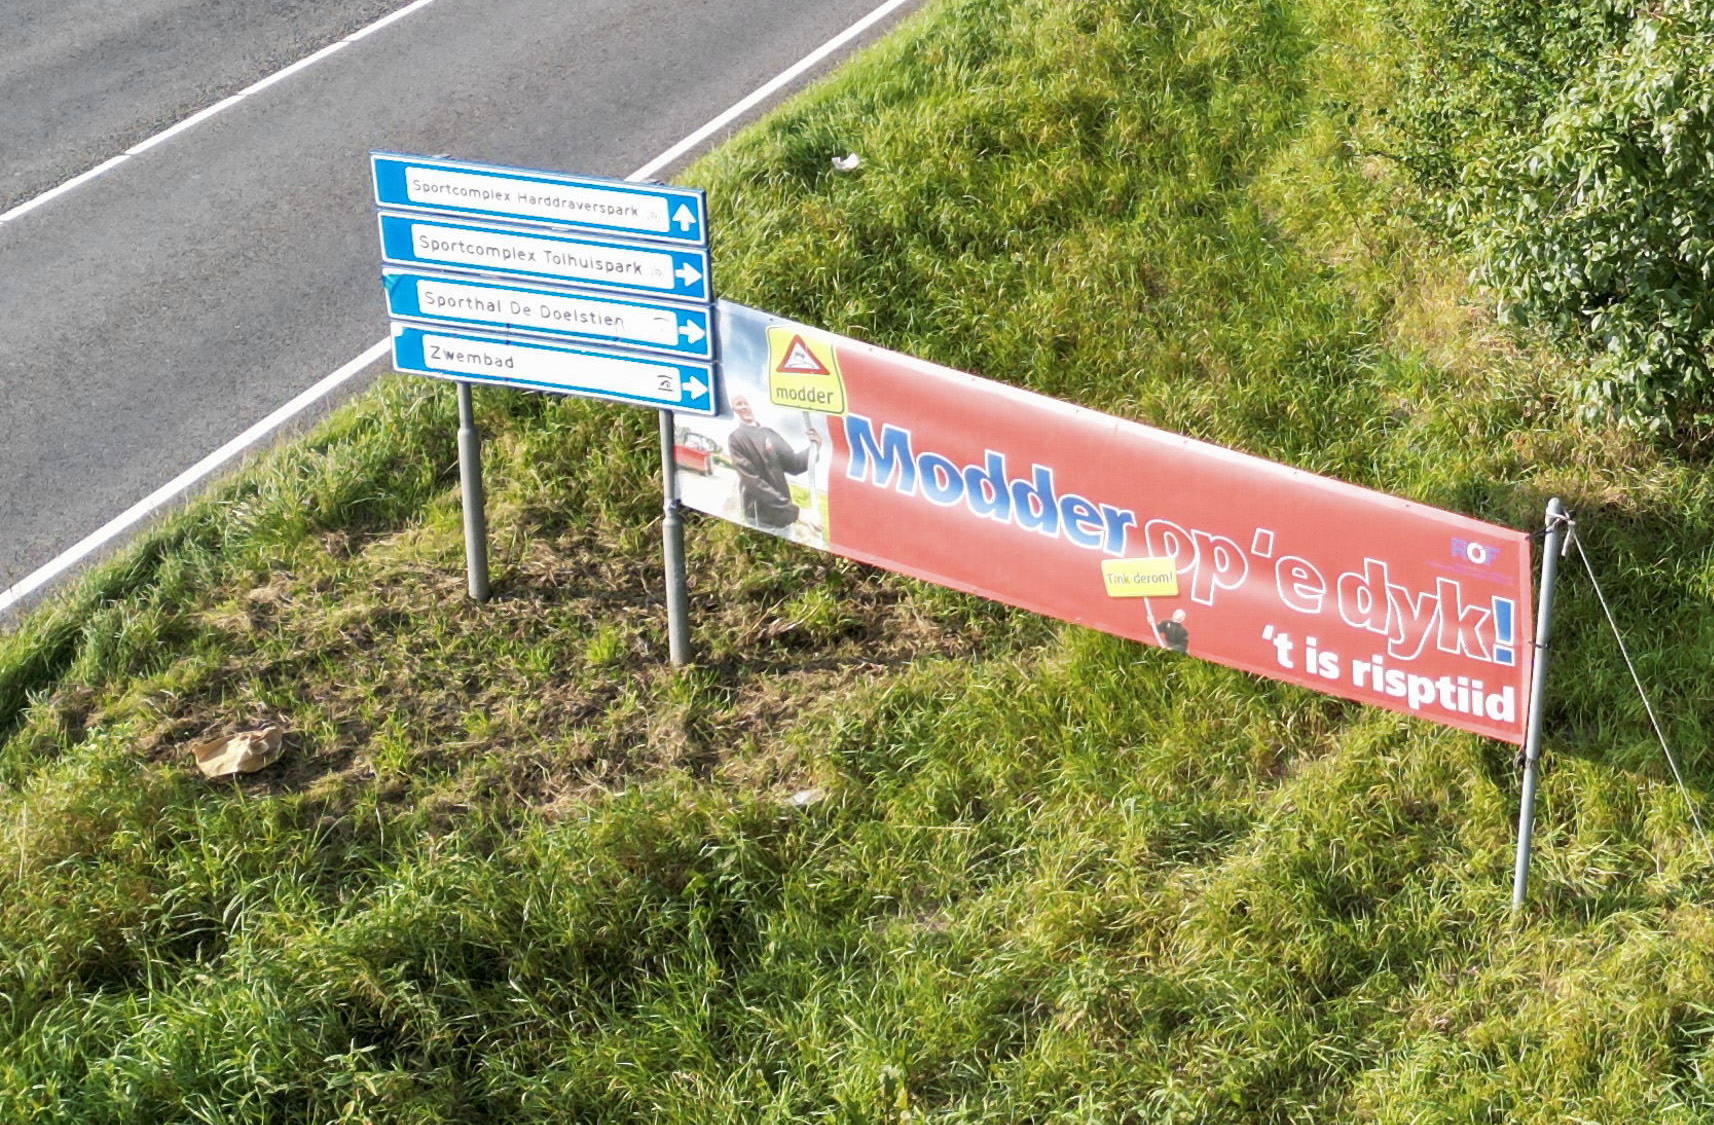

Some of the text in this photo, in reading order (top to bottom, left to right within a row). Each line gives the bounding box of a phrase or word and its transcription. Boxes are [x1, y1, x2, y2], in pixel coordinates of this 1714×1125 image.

[412, 179, 639, 217] Sportcomplex Harddraverspark
[419, 235, 643, 275] Sportcomplex Tolhuispark
[424, 291, 625, 327] Sporthal De Doelstien
[429, 345, 515, 369] Zwembad
[775, 386, 835, 405] modder
[843, 413, 1138, 557] Modder
[1336, 557, 1516, 667] dyk!
[1133, 571, 1173, 584] derom!
[1305, 635, 1340, 680] is
[1351, 654, 1516, 723] risptiid
